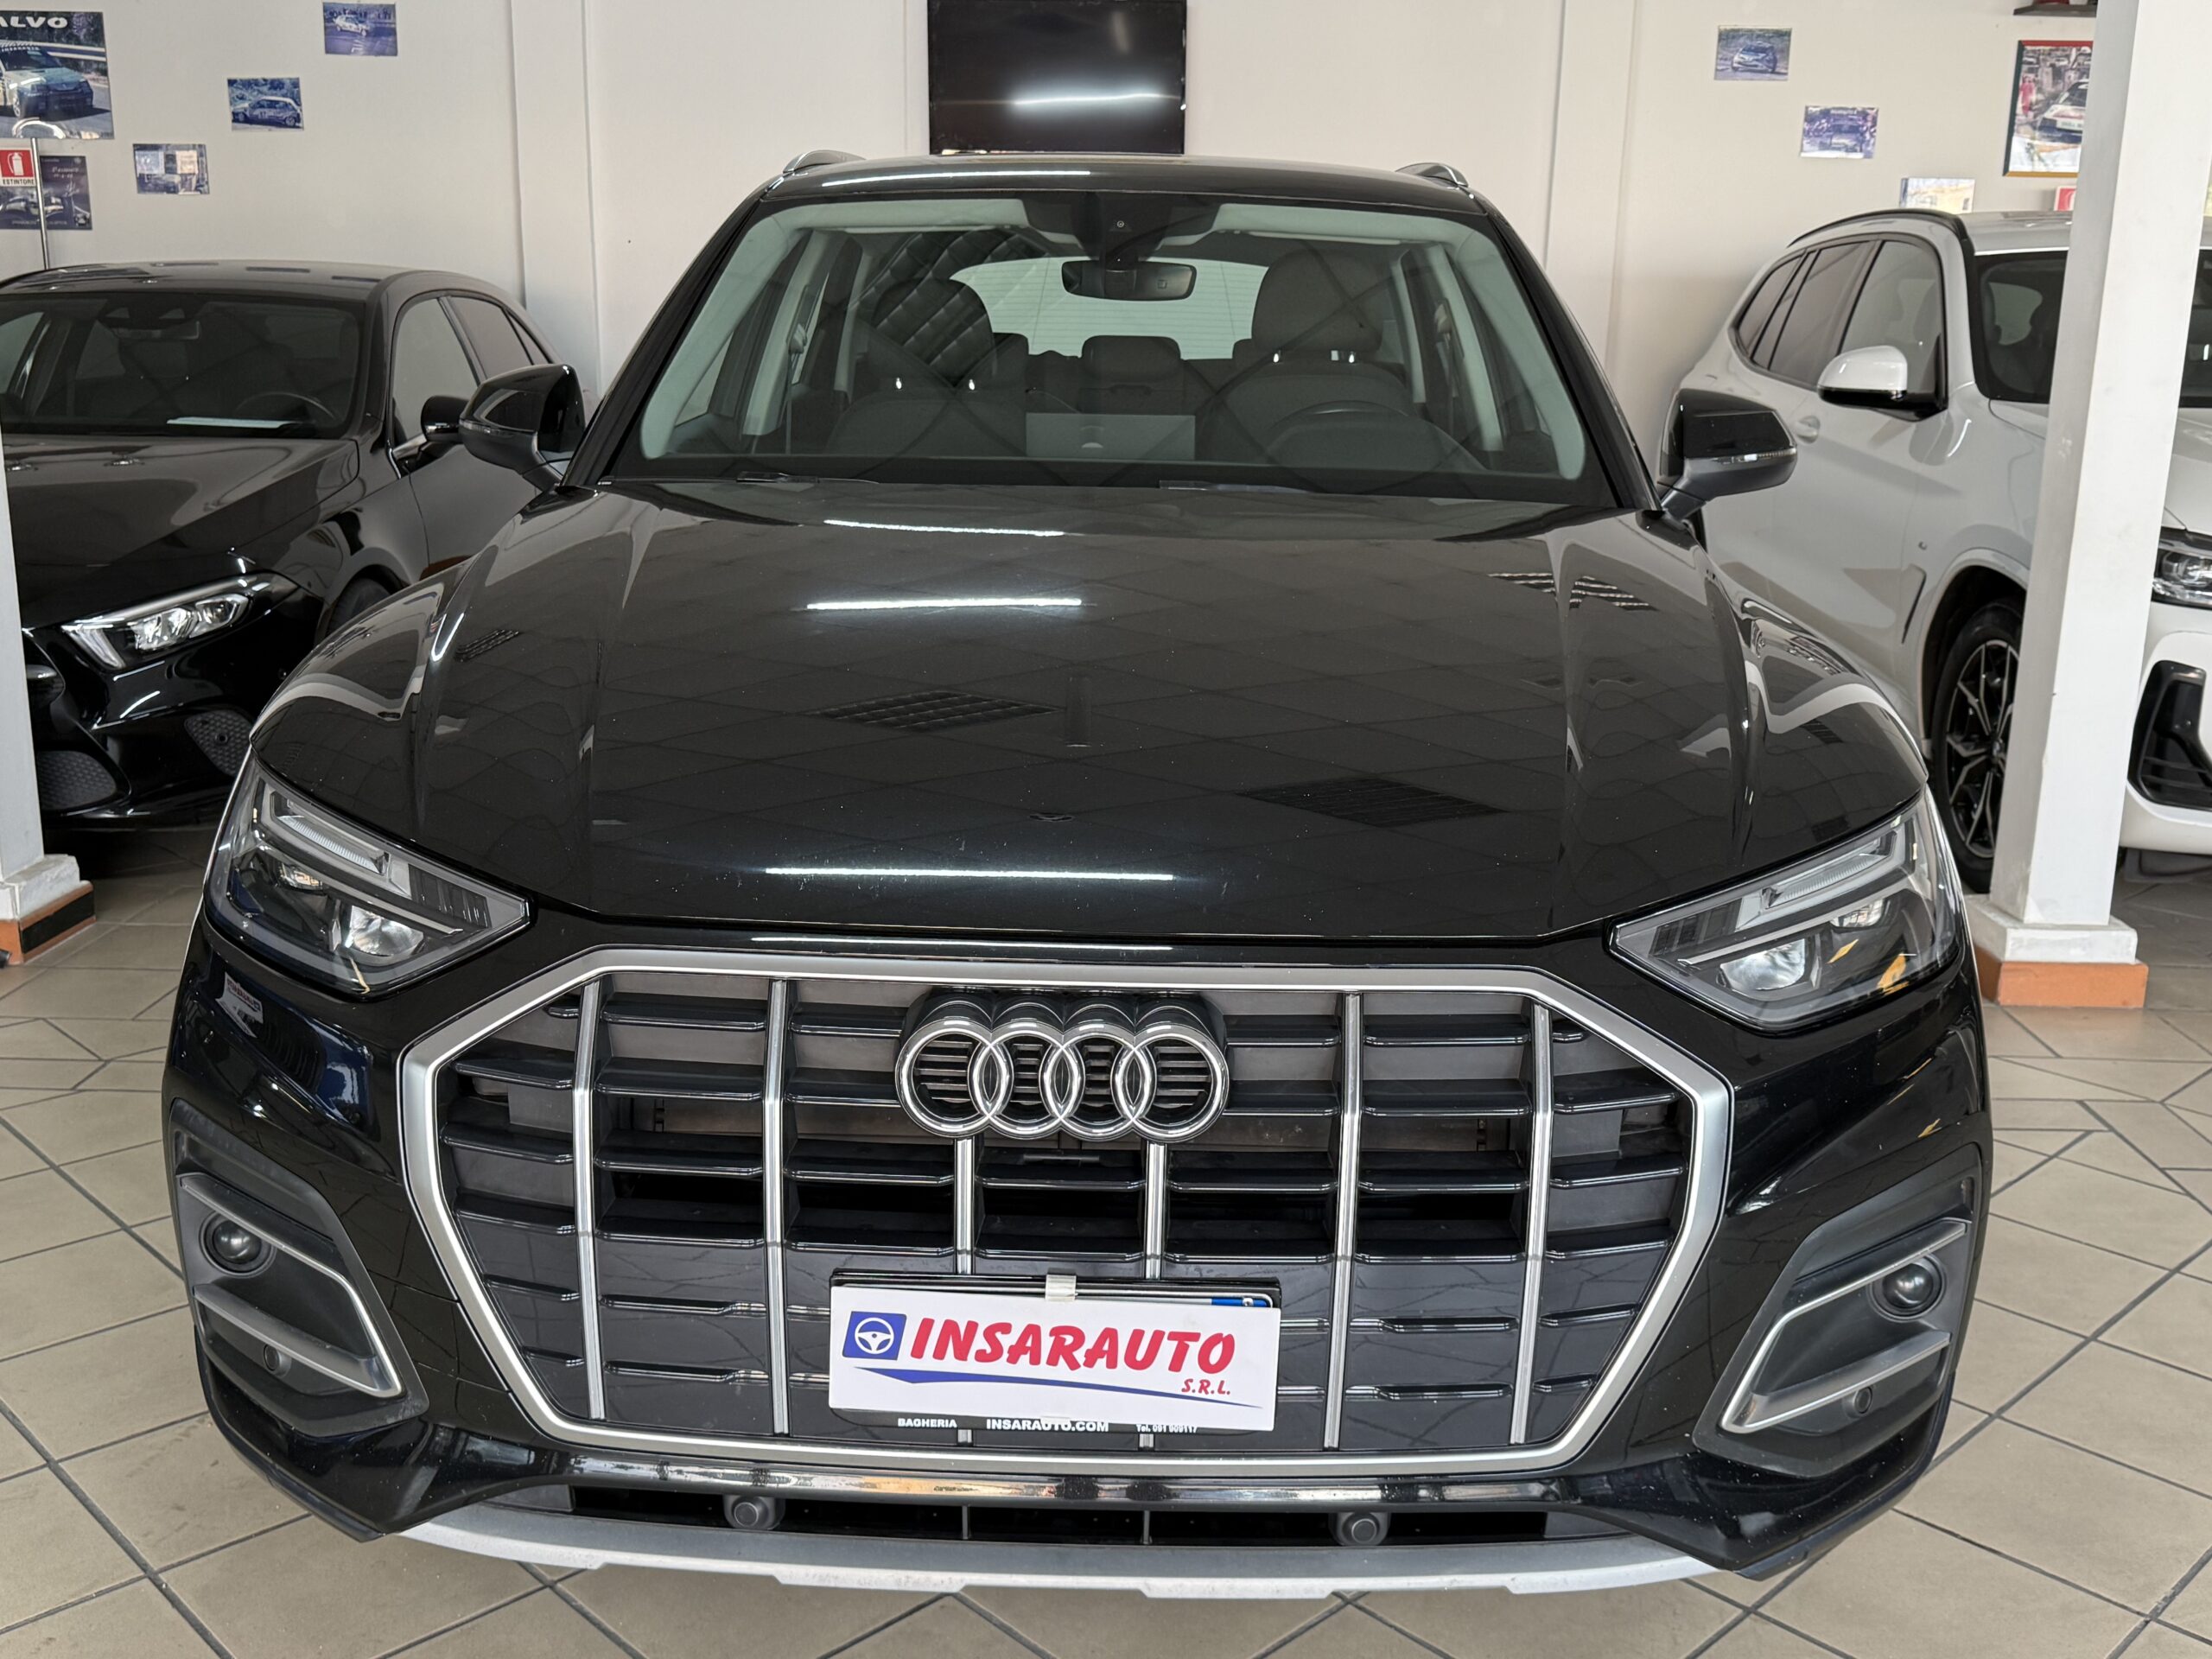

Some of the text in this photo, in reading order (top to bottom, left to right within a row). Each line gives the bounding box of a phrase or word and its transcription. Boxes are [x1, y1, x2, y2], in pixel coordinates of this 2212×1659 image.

[910, 1318, 1236, 1374] INSARAUTO
[1181, 1378, 1231, 1395] S.R.L.
[897, 1417, 957, 1428] BAGHERIA
